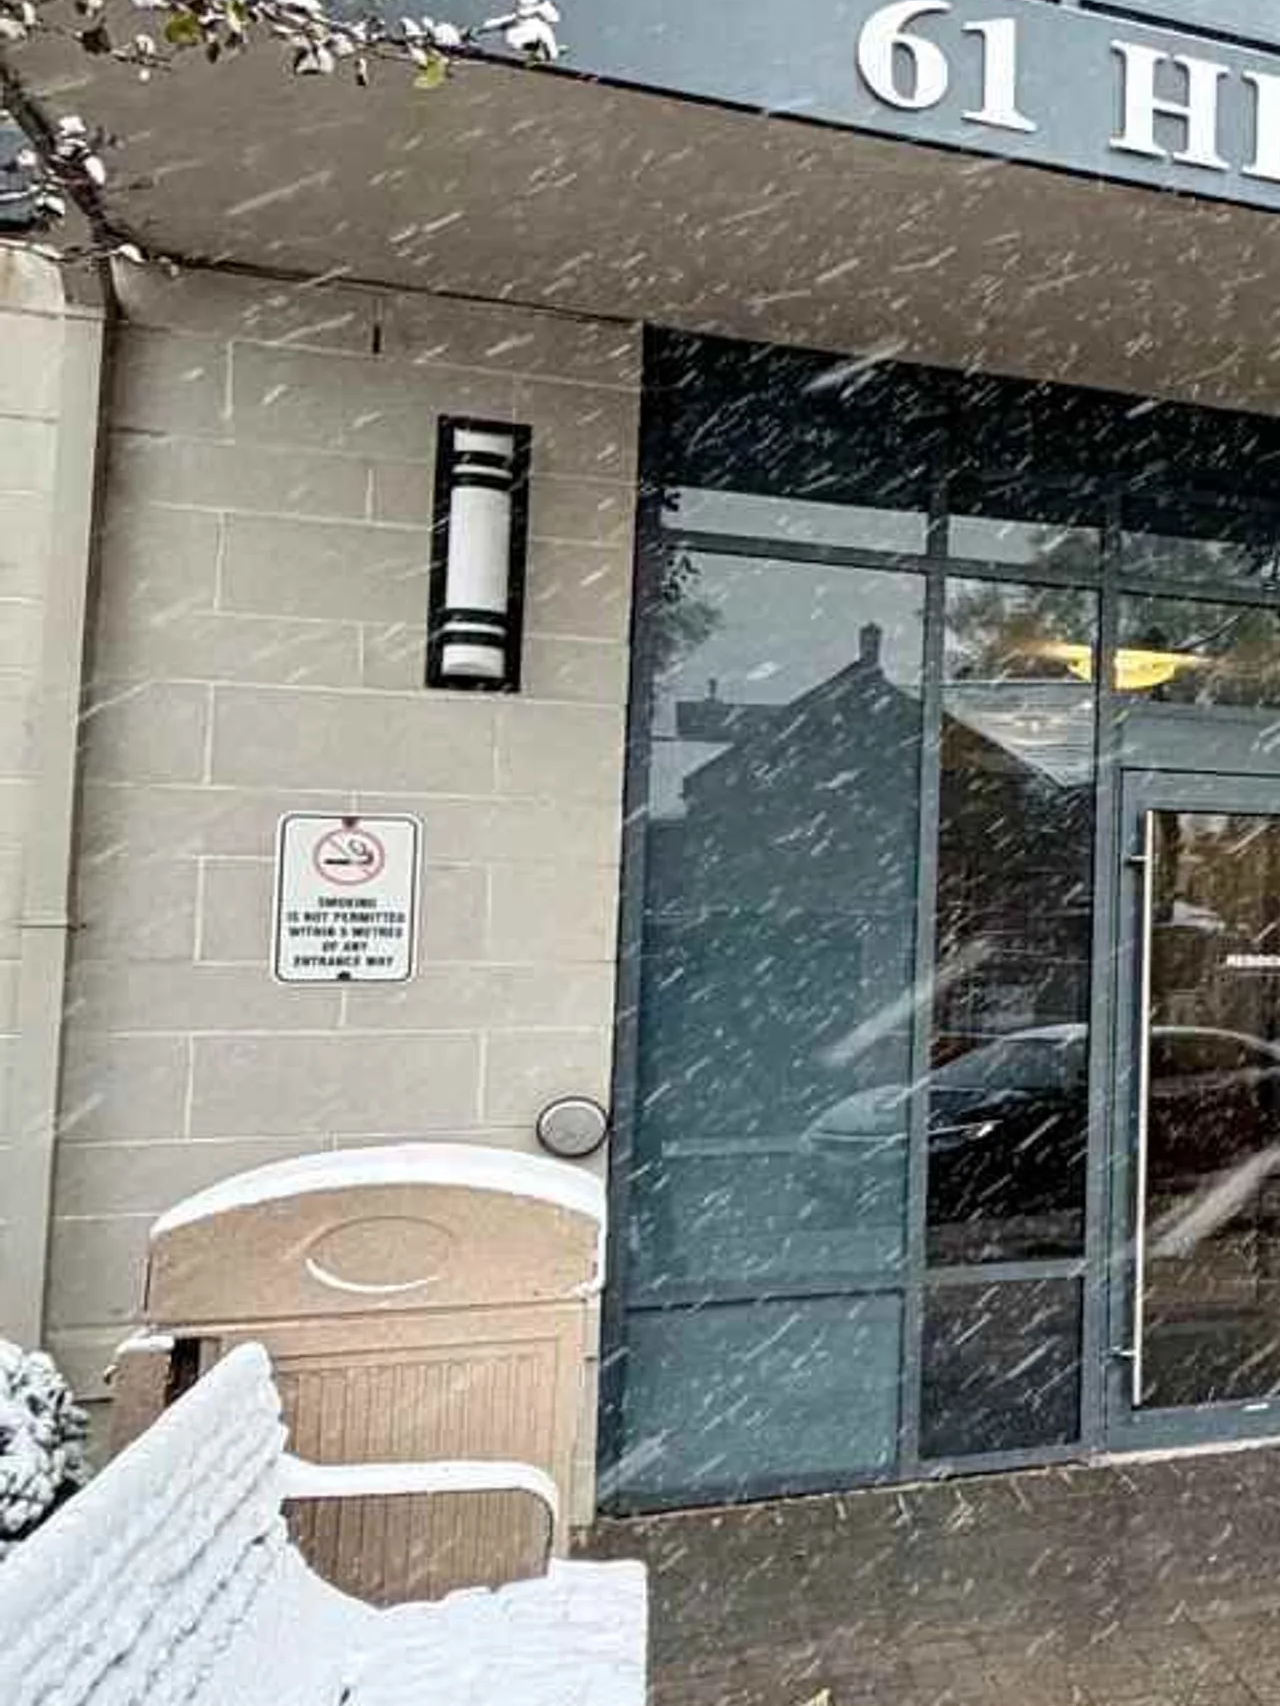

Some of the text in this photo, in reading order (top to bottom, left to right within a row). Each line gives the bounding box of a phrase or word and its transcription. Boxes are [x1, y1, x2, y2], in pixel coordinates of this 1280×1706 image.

[317, 895, 377, 908] SMOKING
[288, 910, 406, 923] IS NOT PERMITTED
[289, 925, 336, 938] WITHIN
[322, 940, 368, 952] OF ANY
[293, 955, 394, 968] ENTRANCE WAY
